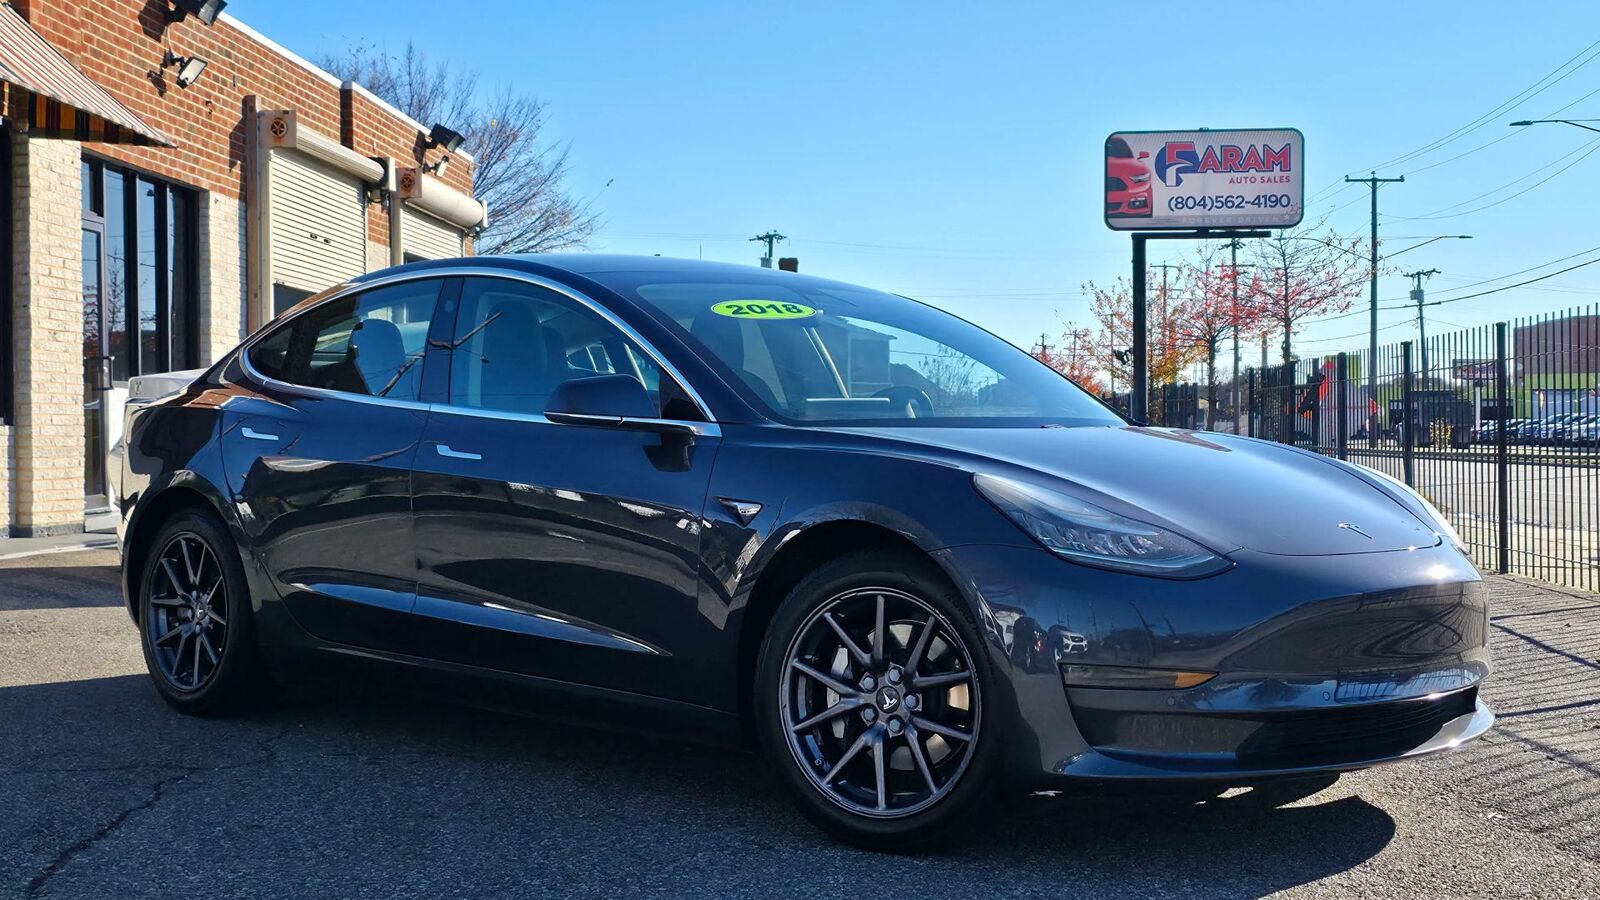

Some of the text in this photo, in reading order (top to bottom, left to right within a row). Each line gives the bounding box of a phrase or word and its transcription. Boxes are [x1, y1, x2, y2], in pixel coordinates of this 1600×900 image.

[1163, 141, 1292, 187] FARAM
[1229, 175, 1291, 185] AUTO SALES
[1168, 194, 1291, 212] (804)562-4190
[725, 303, 804, 315] 2018
